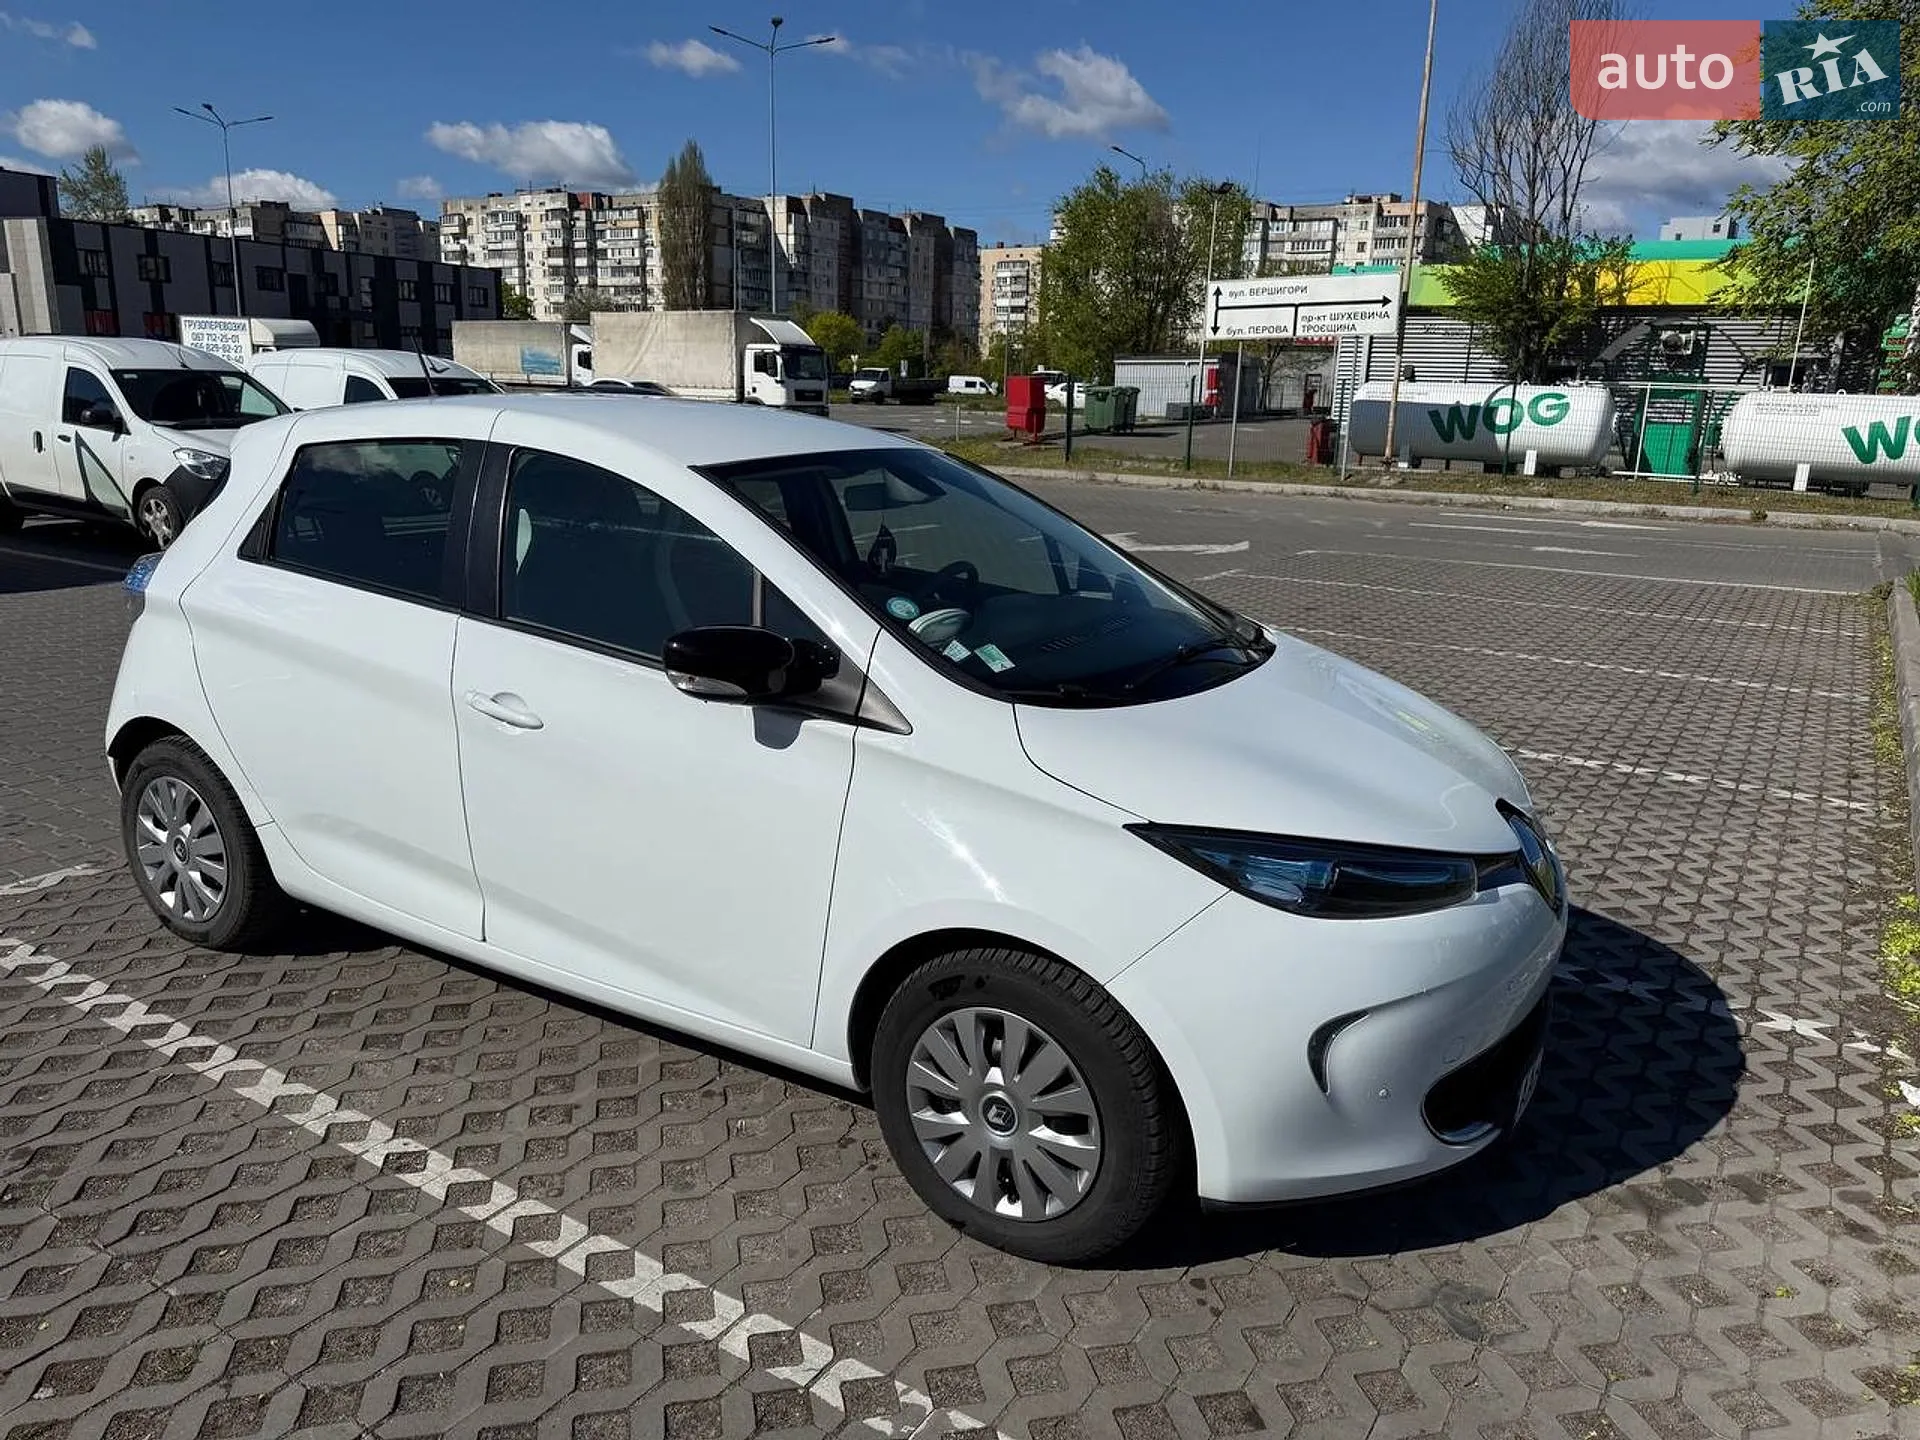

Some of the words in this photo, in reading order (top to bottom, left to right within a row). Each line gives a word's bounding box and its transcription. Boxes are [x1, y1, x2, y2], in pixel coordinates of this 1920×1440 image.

[1249, 286, 1308, 296] ВЕРШИГОРИ
[1301, 314, 1327, 323] пр-кт
[1329, 311, 1390, 321] ШУХЕВИЧА
[1248, 325, 1288, 335] ПЕРОВА
[1301, 323, 1357, 333] ТРОЄЩИНА
[1428, 392, 1571, 443] WOG
[1841, 415, 1920, 465] W
